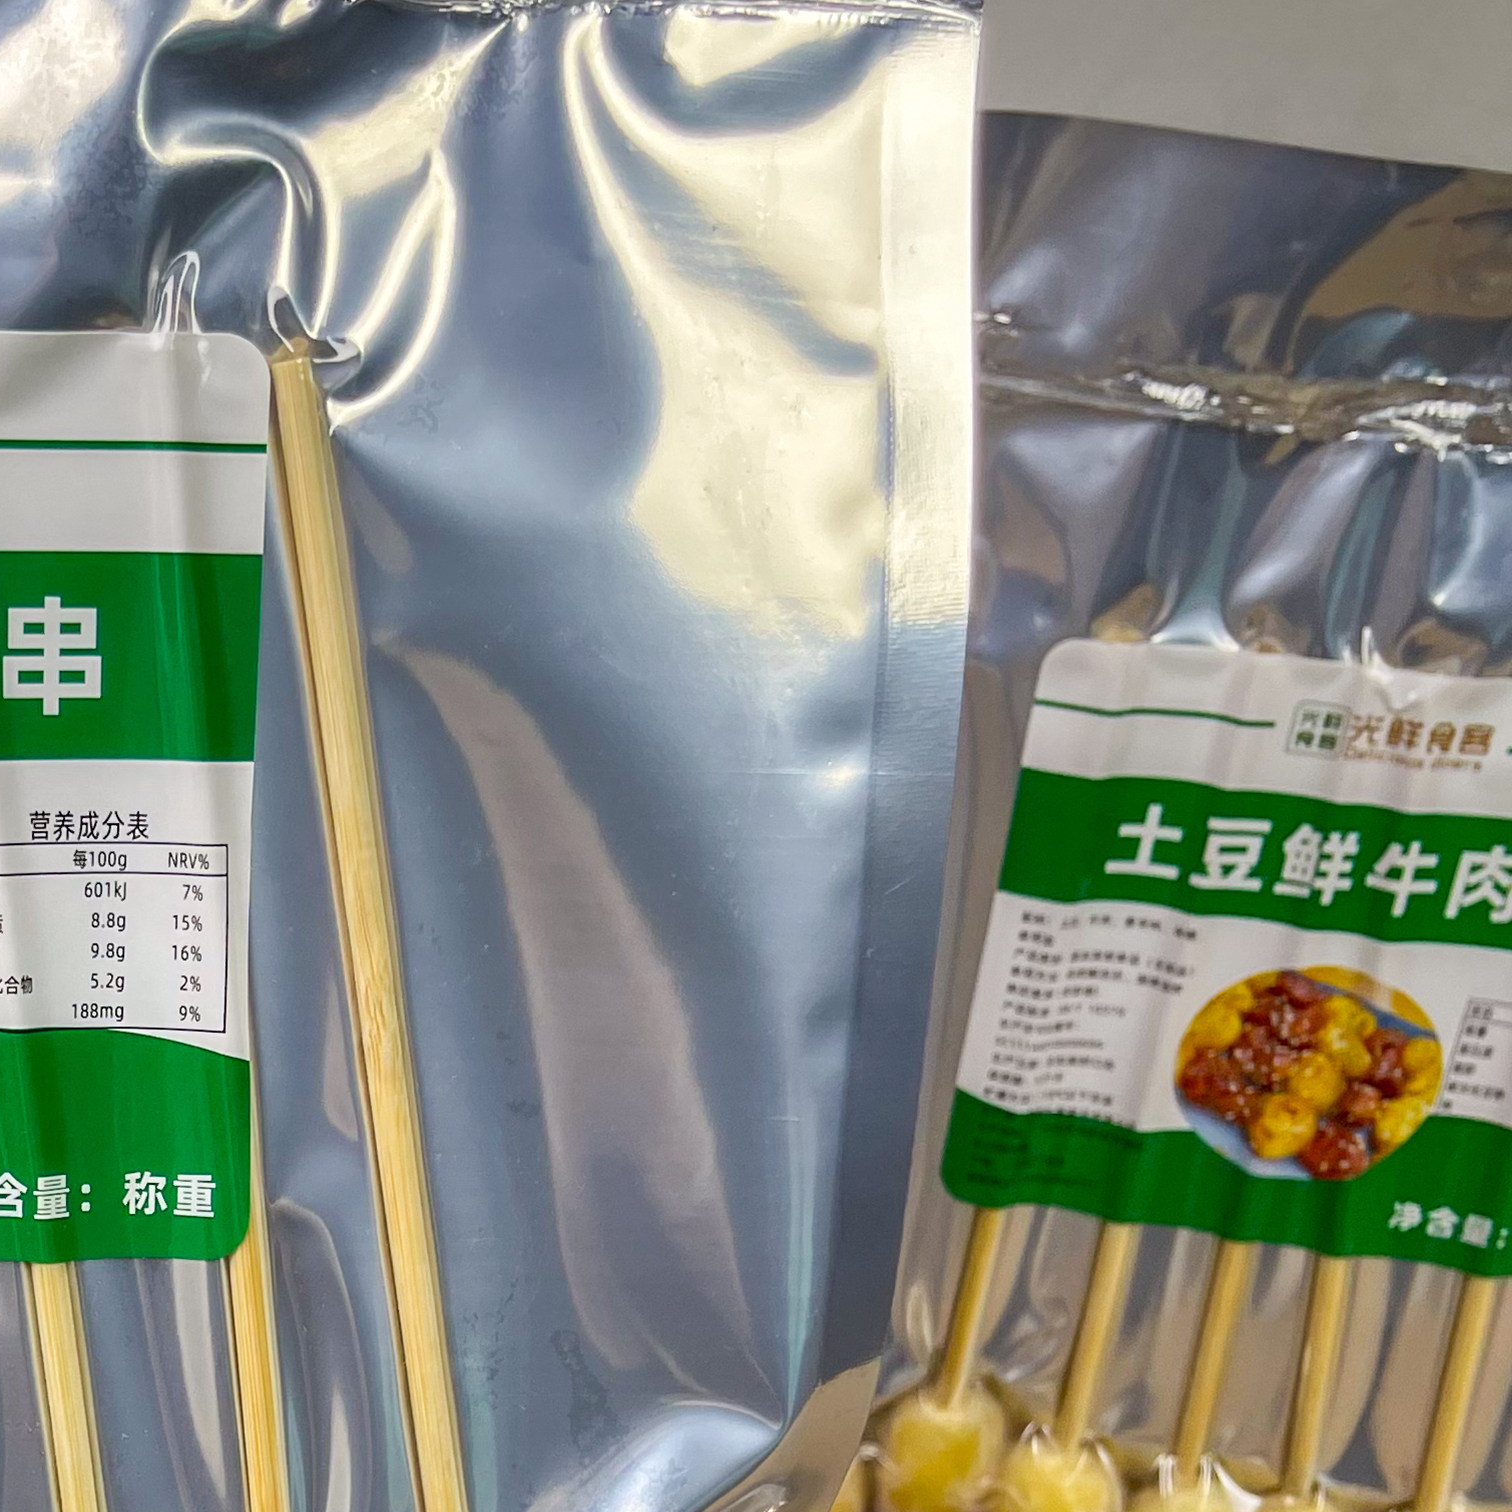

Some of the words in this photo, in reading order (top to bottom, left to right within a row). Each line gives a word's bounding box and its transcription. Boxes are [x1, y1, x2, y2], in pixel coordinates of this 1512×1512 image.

[29, 810, 150, 841] 营养成分表
[72, 849, 128, 871] 每100g
[168, 851, 210, 870] NRV%
[182, 884, 204, 901] 7%
[91, 912, 127, 932] 8.8g
[172, 915, 203, 932] 15%
[91, 942, 126, 962] 9.8g
[171, 945, 203, 962] 16%
[90, 973, 125, 992] 5.2g
[179, 975, 202, 992] 2%
[71, 1003, 125, 1022] 188mg
[179, 1005, 201, 1022] 9%
